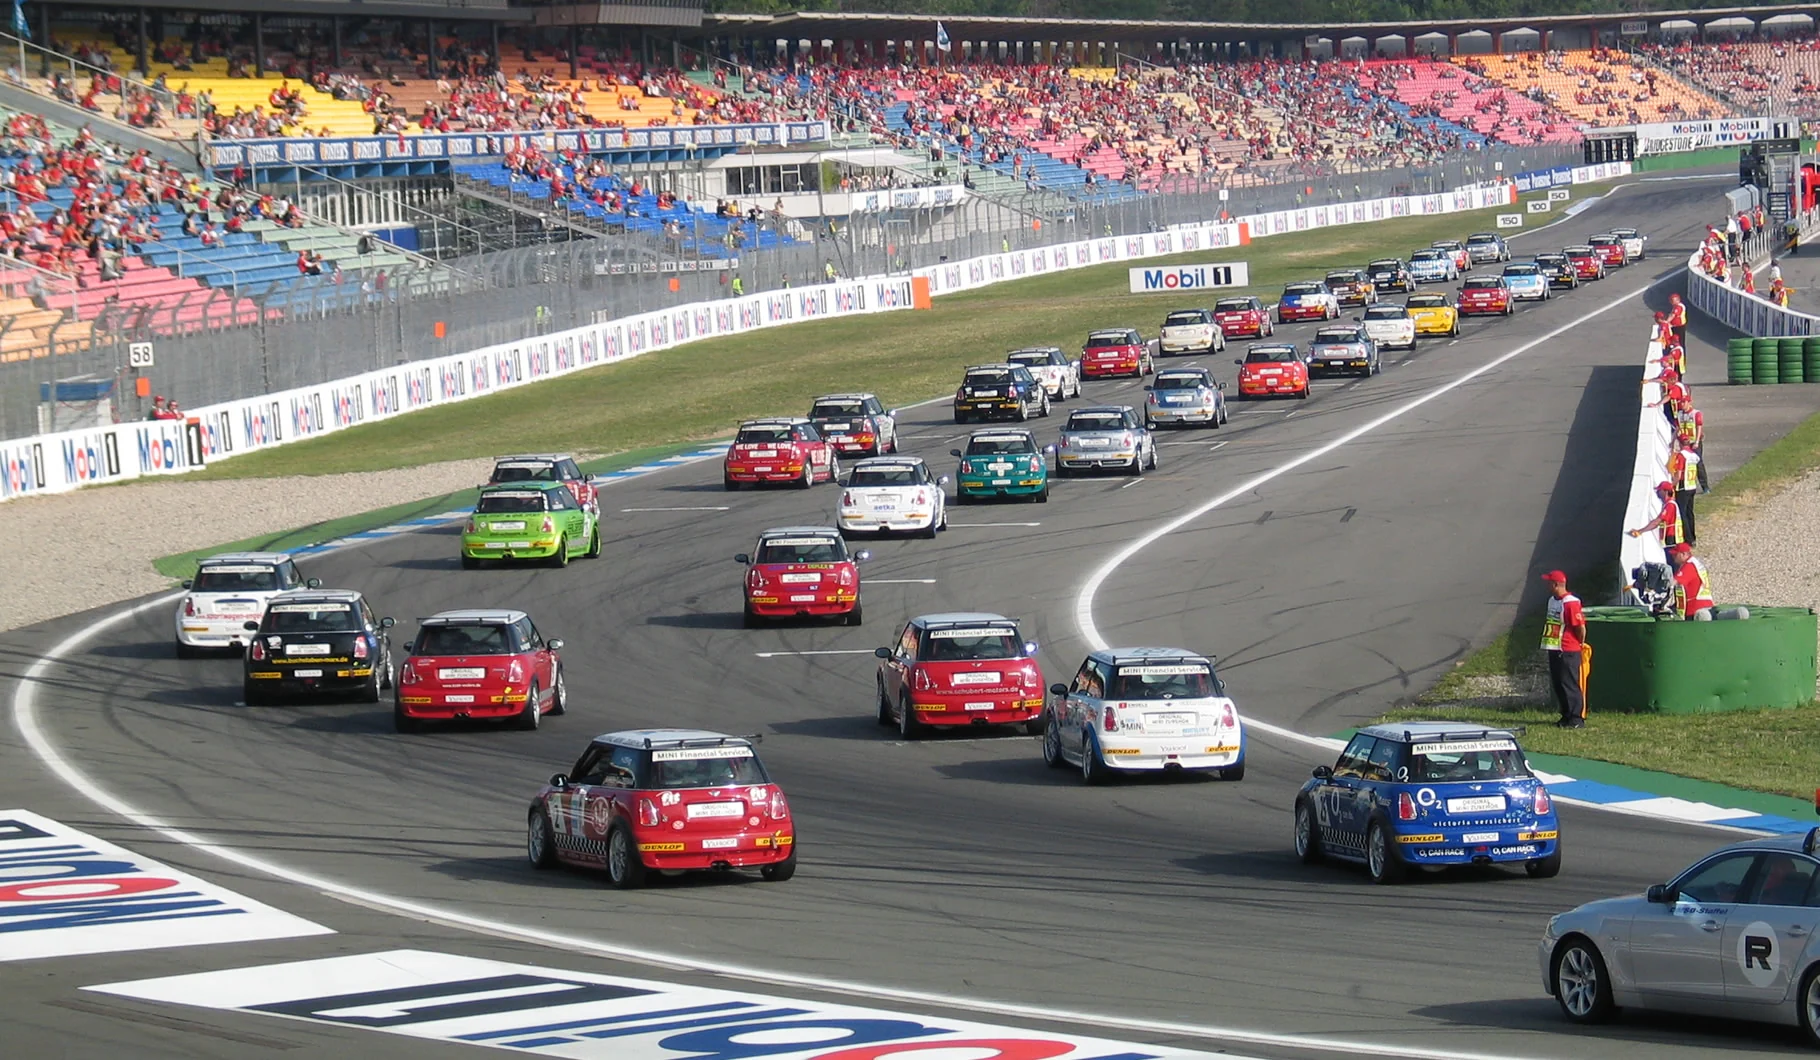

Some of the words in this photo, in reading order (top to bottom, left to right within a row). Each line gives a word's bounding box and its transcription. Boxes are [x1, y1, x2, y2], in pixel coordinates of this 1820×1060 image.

[1673, 124, 1702, 134] Mobil
[1704, 123, 1712, 132] 1
[1720, 122, 1749, 131] Mobil
[1751, 121, 1759, 129] 1
[1551, 192, 1566, 200] 50
[1531, 203, 1547, 211] 100
[1501, 216, 1518, 225] 150
[1145, 269, 1205, 289] Mobil
[1215, 267, 1229, 285] 1
[877, 282, 903, 308] Mobil
[133, 346, 150, 363] 58
[290, 394, 316, 436] Mobil
[243, 403, 273, 448] Mobil
[200, 412, 222, 457] obil
[220, 411, 233, 452] 1
[136, 423, 186, 474] Mobil
[187, 422, 204, 466] 1
[61, 433, 106, 484] Mobil
[105, 432, 120, 476] 1
[0, 445, 35, 497] Mobil
[33, 443, 46, 488] 1
[1416, 744, 1438, 753] MINI
[1440, 742, 1477, 751] Financial
[1479, 740, 1512, 749] Services
[657, 751, 678, 760] MINI
[680, 749, 717, 759] Financial
[718, 748, 750, 757] Services
[1433, 819, 1471, 828] victoria
[1475, 817, 1521, 826] versichert
[762, 837, 792, 845] DNLOP
[1402, 835, 1442, 843] DUNLOP
[1428, 849, 1444, 857] CAN
[1445, 848, 1464, 856] RACE
[1501, 846, 1517, 854] CAN
[0, 845, 252, 934] Mob
[1745, 935, 1772, 970] R
